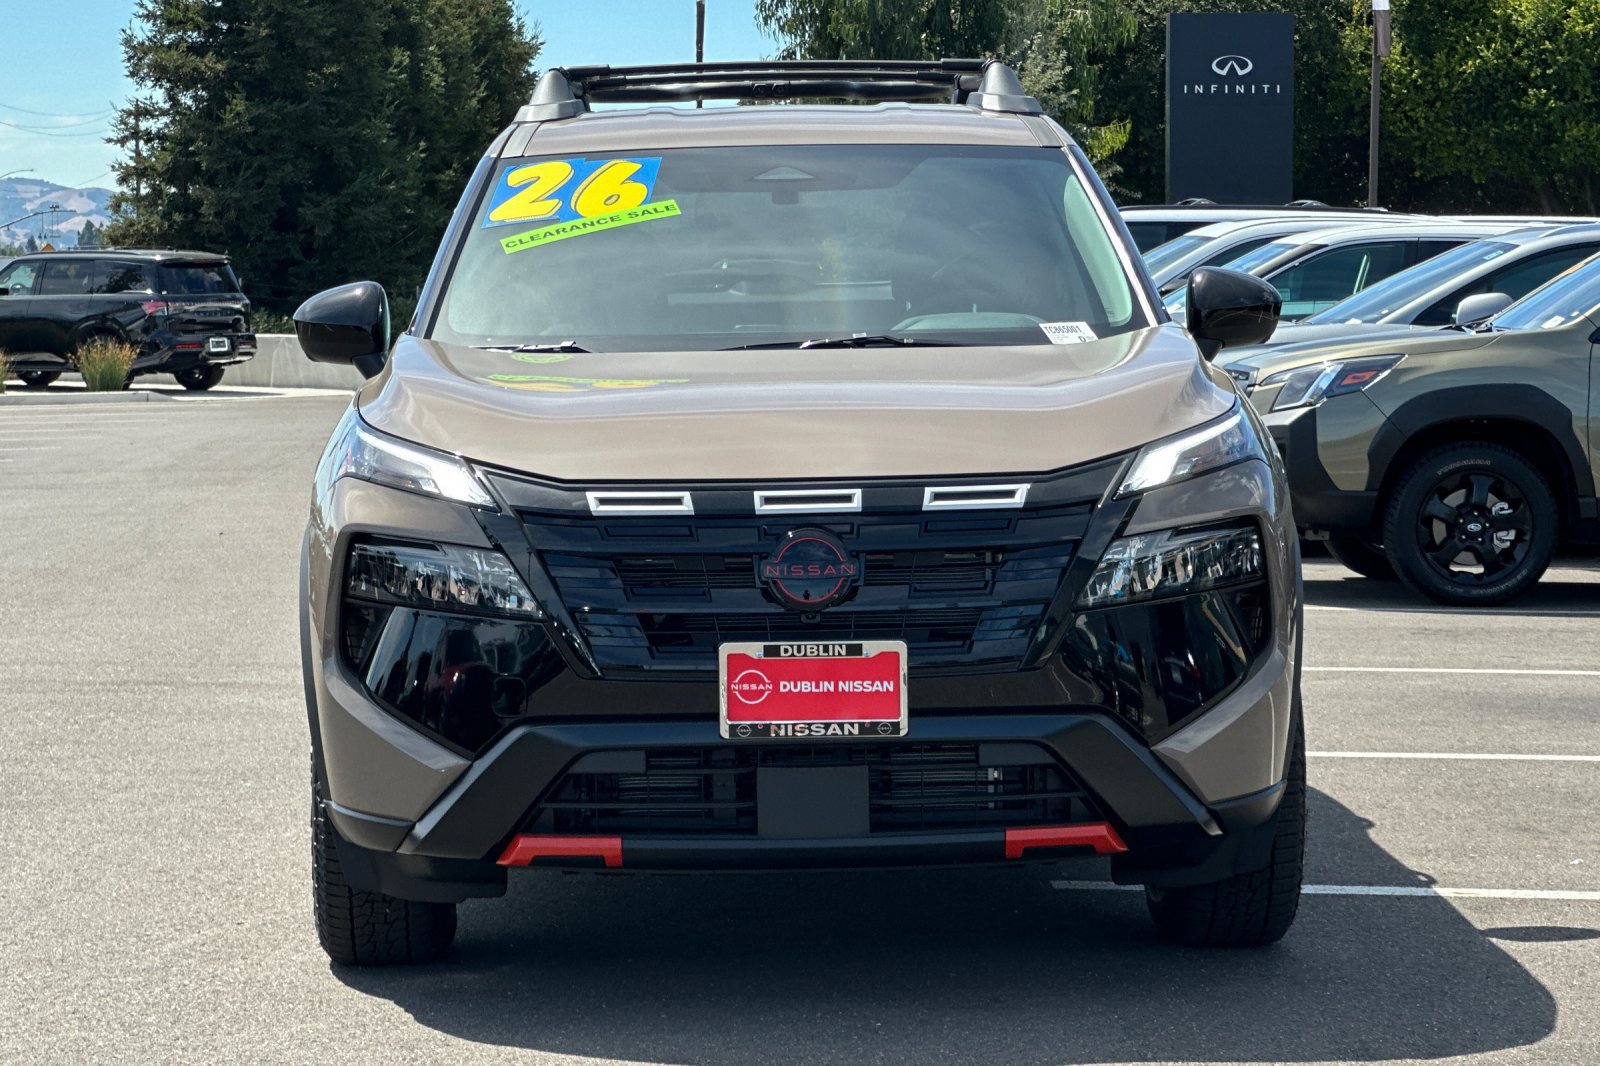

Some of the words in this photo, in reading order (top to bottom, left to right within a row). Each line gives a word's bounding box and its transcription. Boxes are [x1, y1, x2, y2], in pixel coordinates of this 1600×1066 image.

[1184, 84, 1280, 94] INFINITI
[489, 159, 648, 222] 26
[505, 214, 620, 249] CLEARANCE
[628, 203, 677, 219] SALE
[765, 564, 855, 576] NISSAN
[780, 644, 847, 657] DUBLIN
[779, 681, 834, 693] DUBLIN
[838, 681, 894, 692] NISSAN
[770, 723, 859, 736] NISSAN
